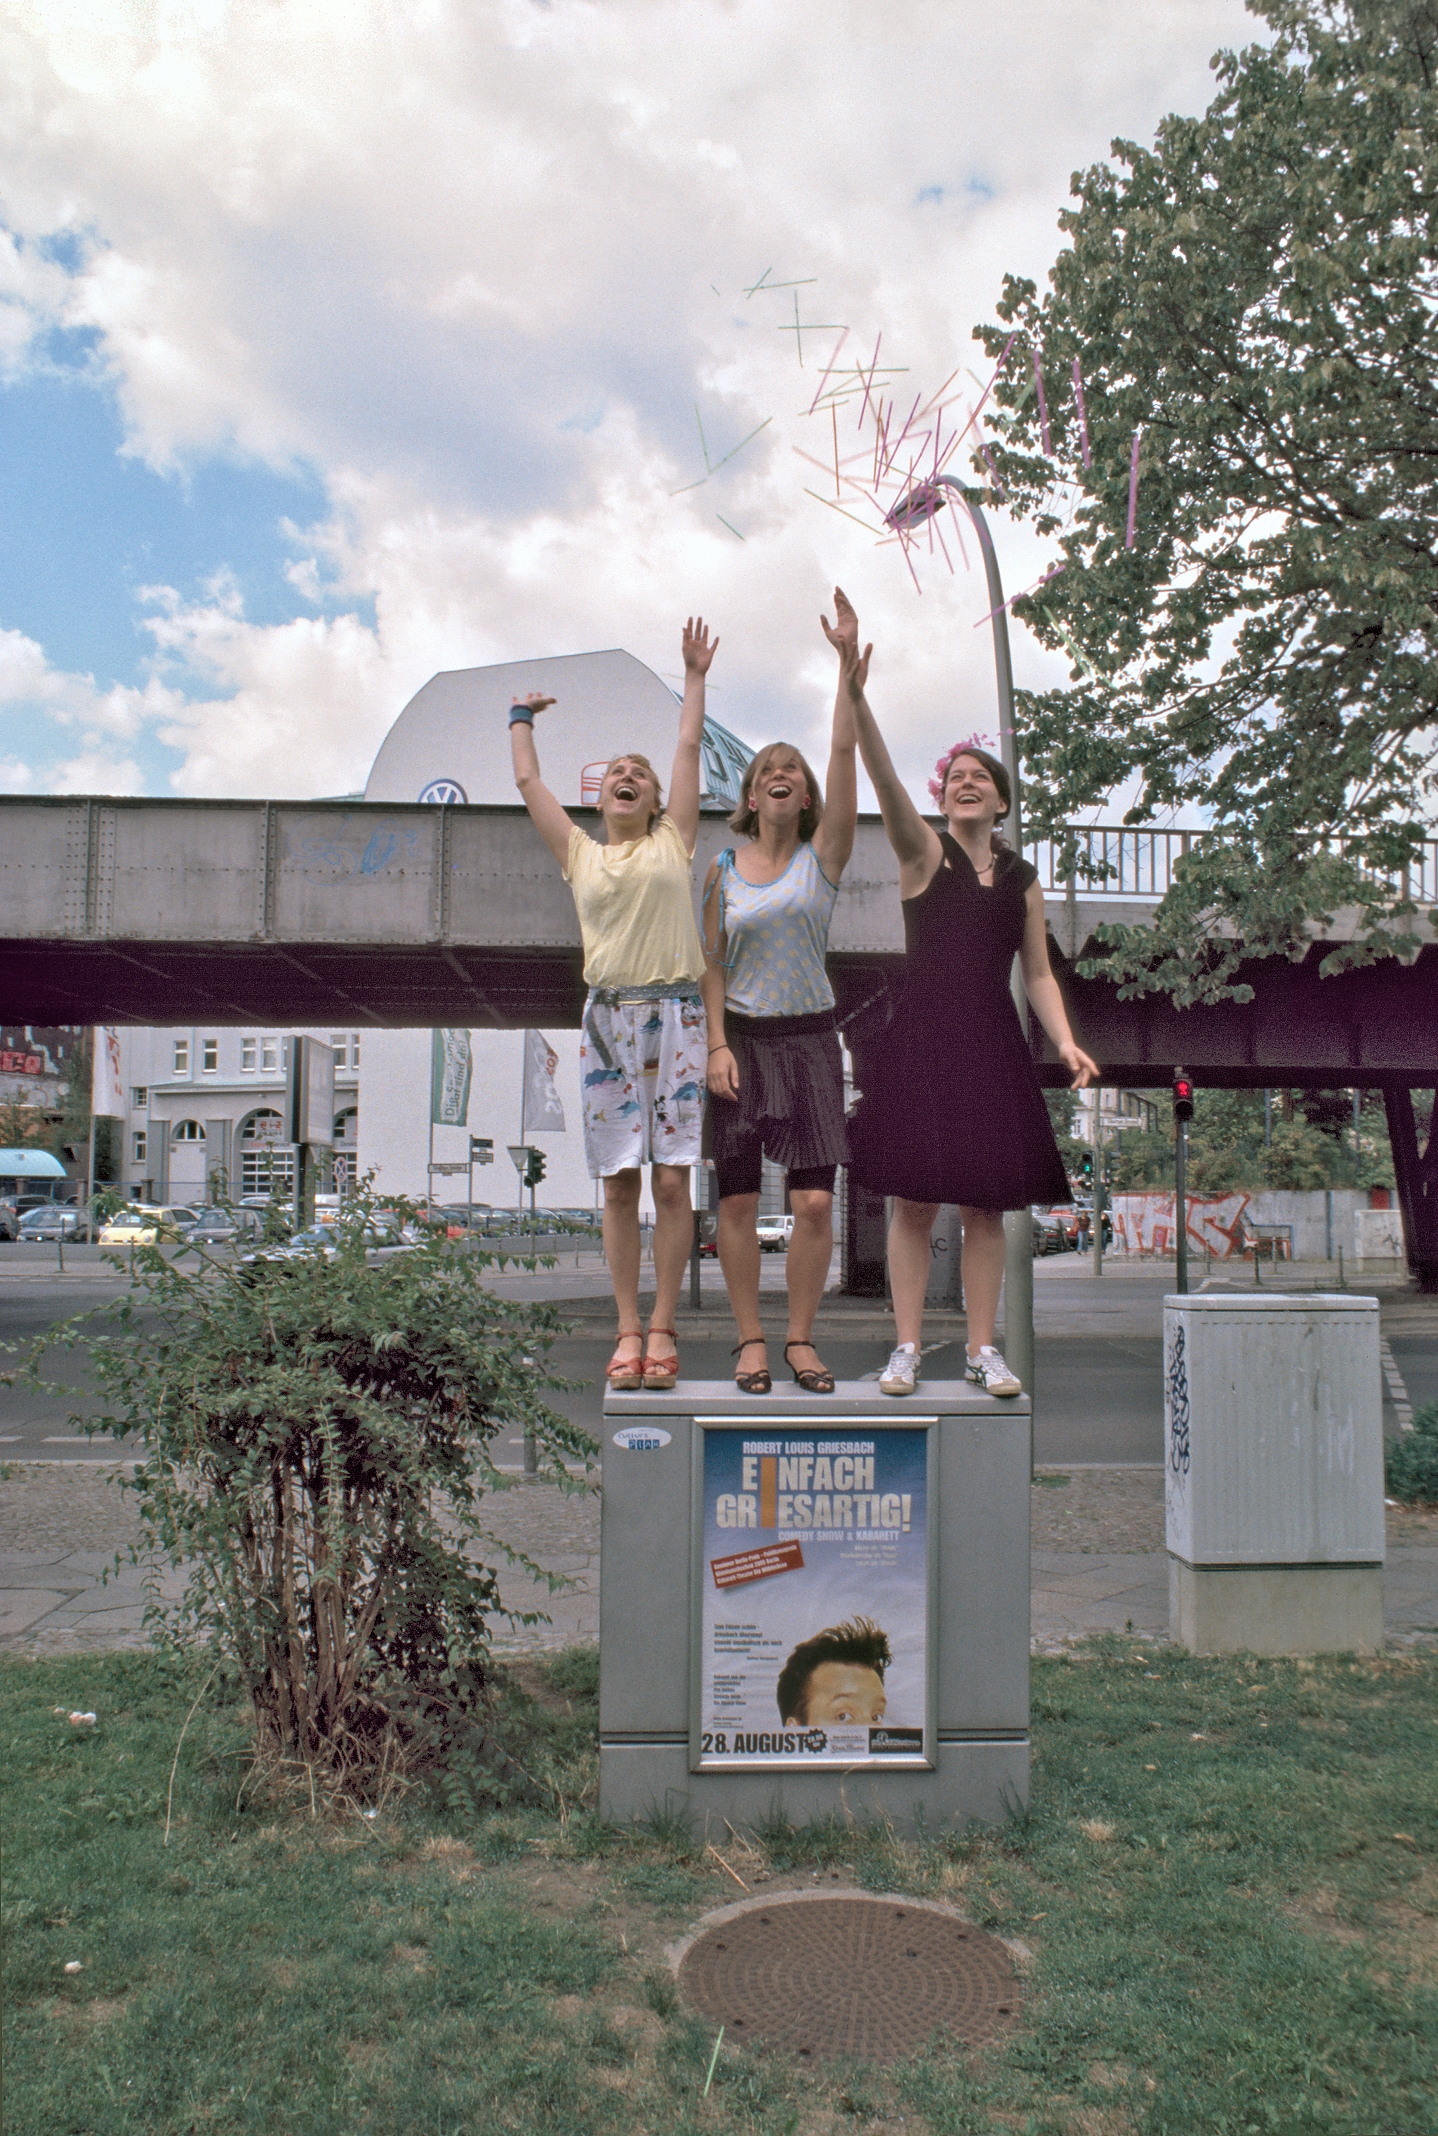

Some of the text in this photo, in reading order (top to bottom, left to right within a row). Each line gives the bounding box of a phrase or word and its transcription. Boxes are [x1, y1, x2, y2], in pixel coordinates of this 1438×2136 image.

[742, 1441, 875, 1454] ROBERT LOUIS GRIESBACH
[742, 1456, 875, 1491] EINFACH
[716, 1493, 912, 1533] GRIESARTIG!
[778, 1530, 900, 1542] COMEDY SHOW & KABARETT
[702, 1732, 731, 1754] 28.
[733, 1732, 806, 1754] AUGUST
